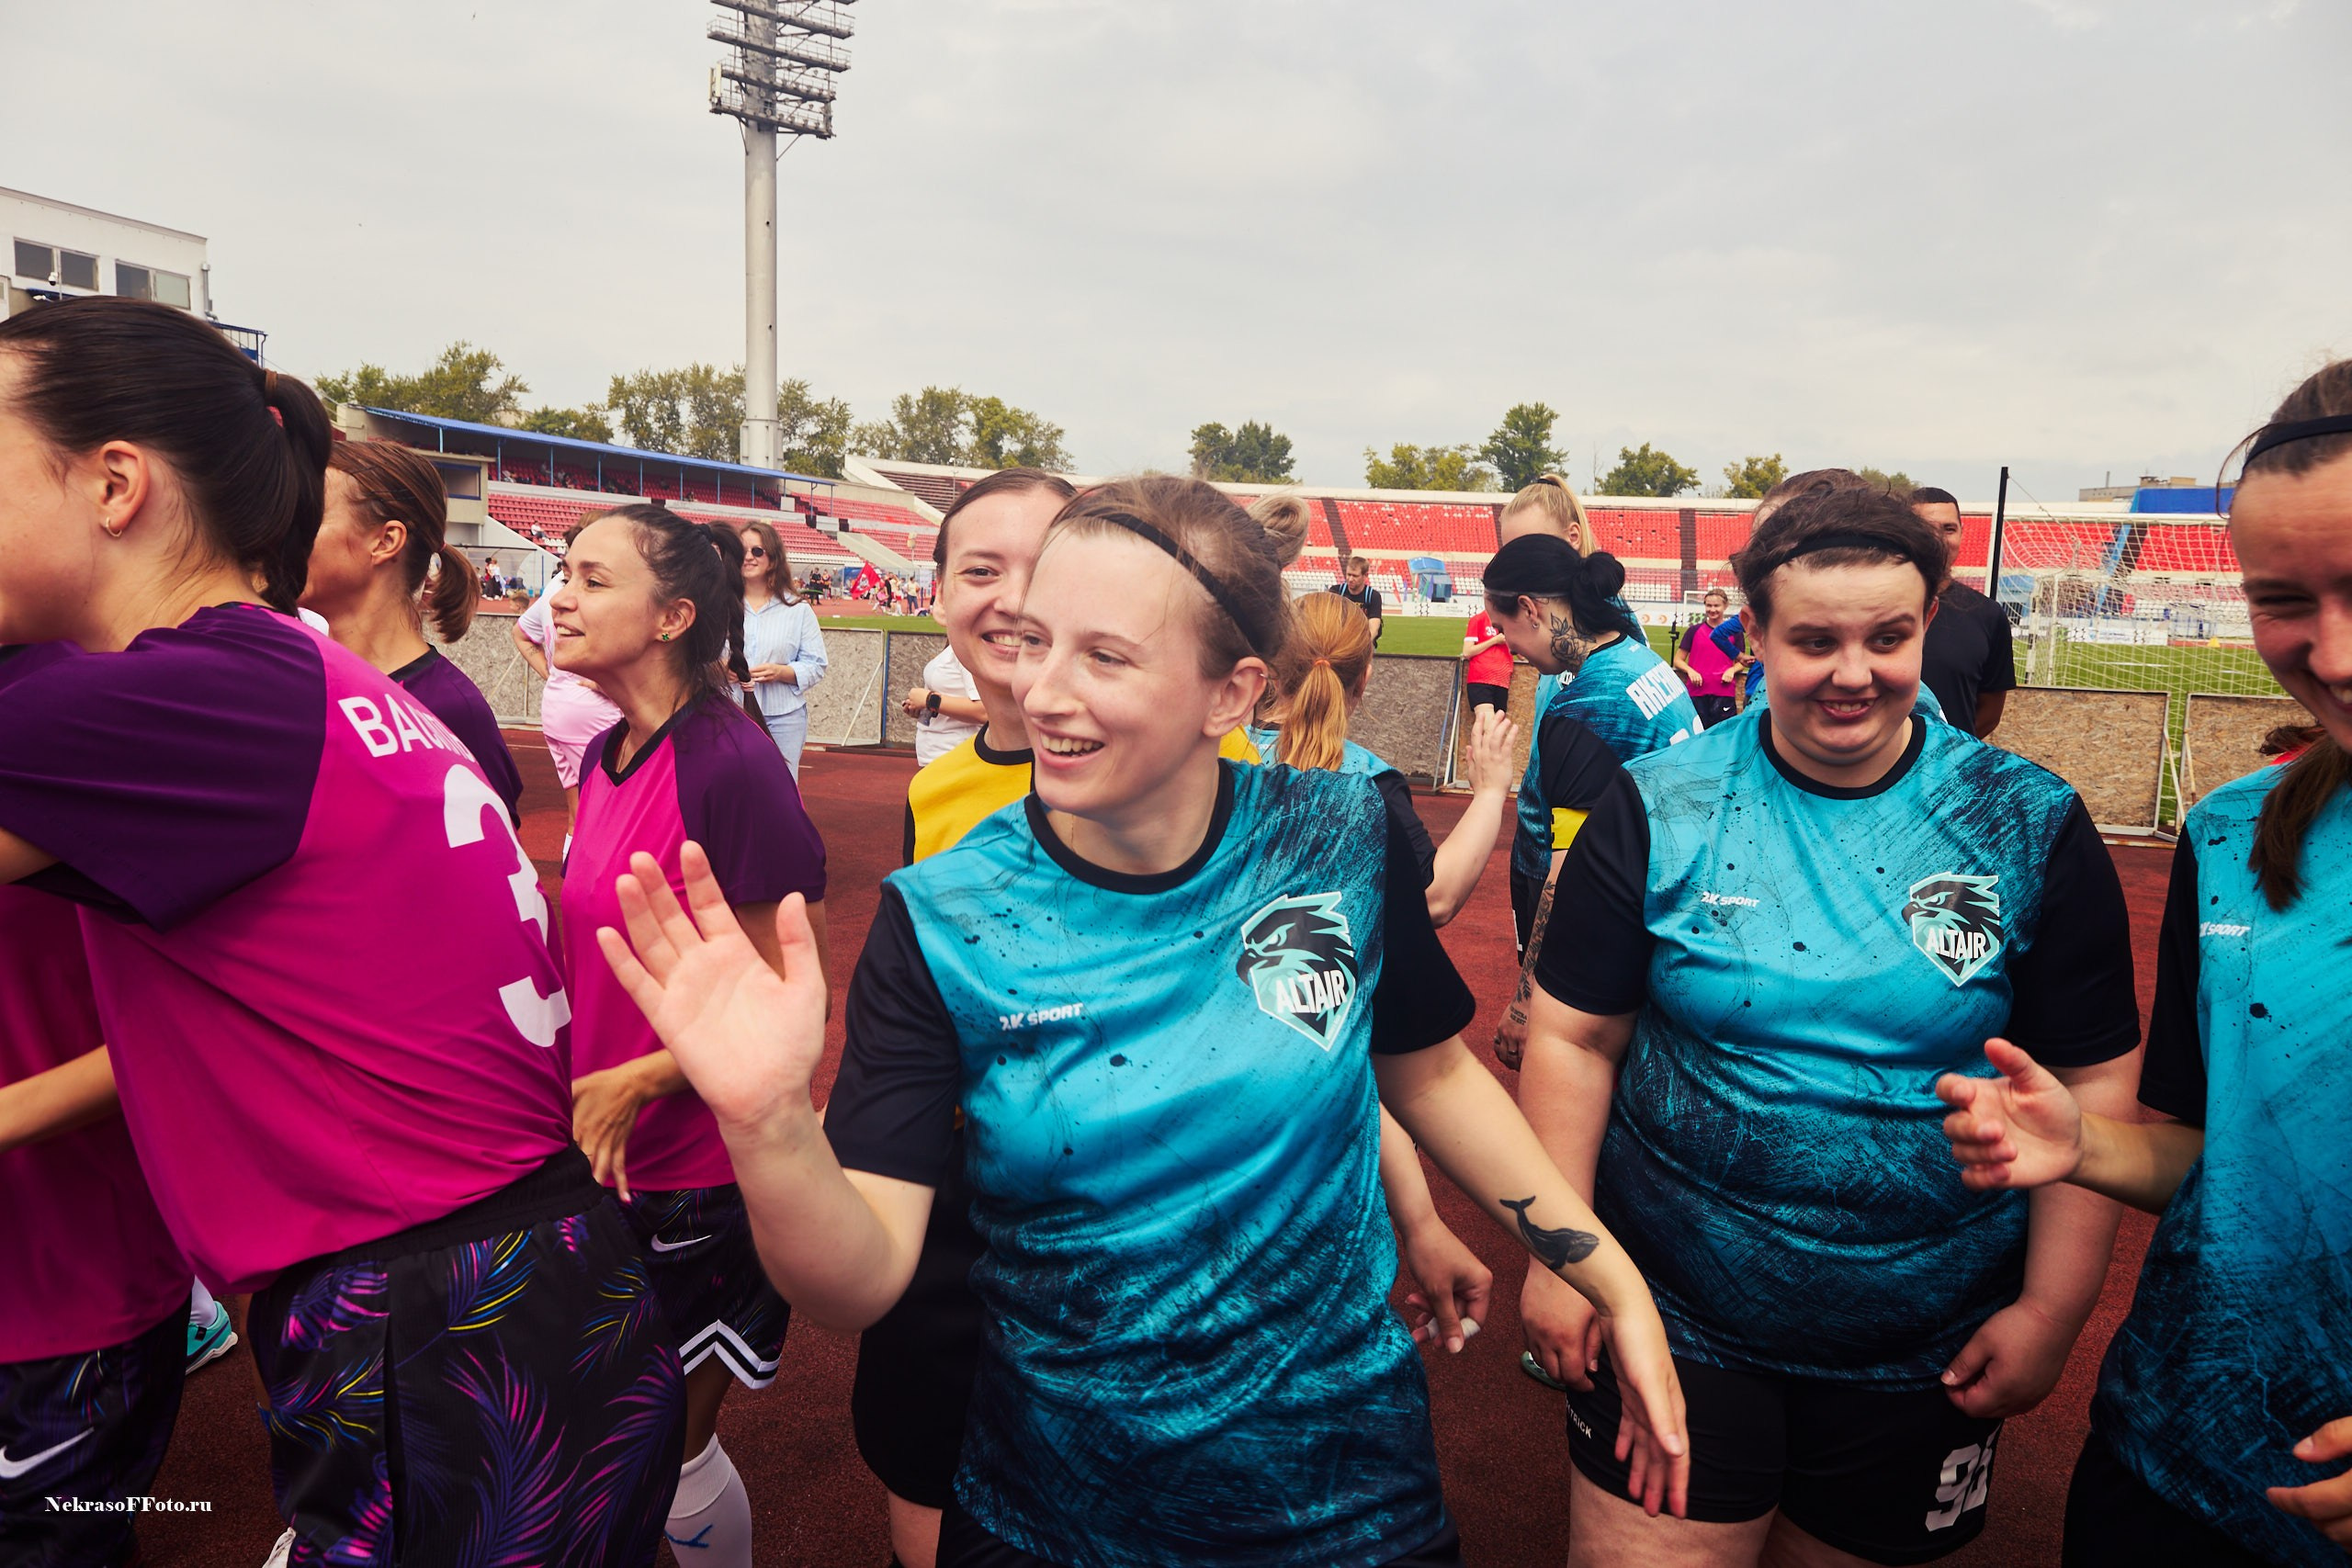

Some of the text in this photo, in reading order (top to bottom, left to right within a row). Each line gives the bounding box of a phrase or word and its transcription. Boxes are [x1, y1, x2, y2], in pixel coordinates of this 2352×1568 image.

[1719, 896, 1760, 908] SPORT
[2207, 923, 2252, 937] SPORT
[1926, 927, 1987, 960] ALTAIR
[1275, 969, 1348, 1014] ALTAIR
[1026, 1002, 1084, 1026] SPORT
